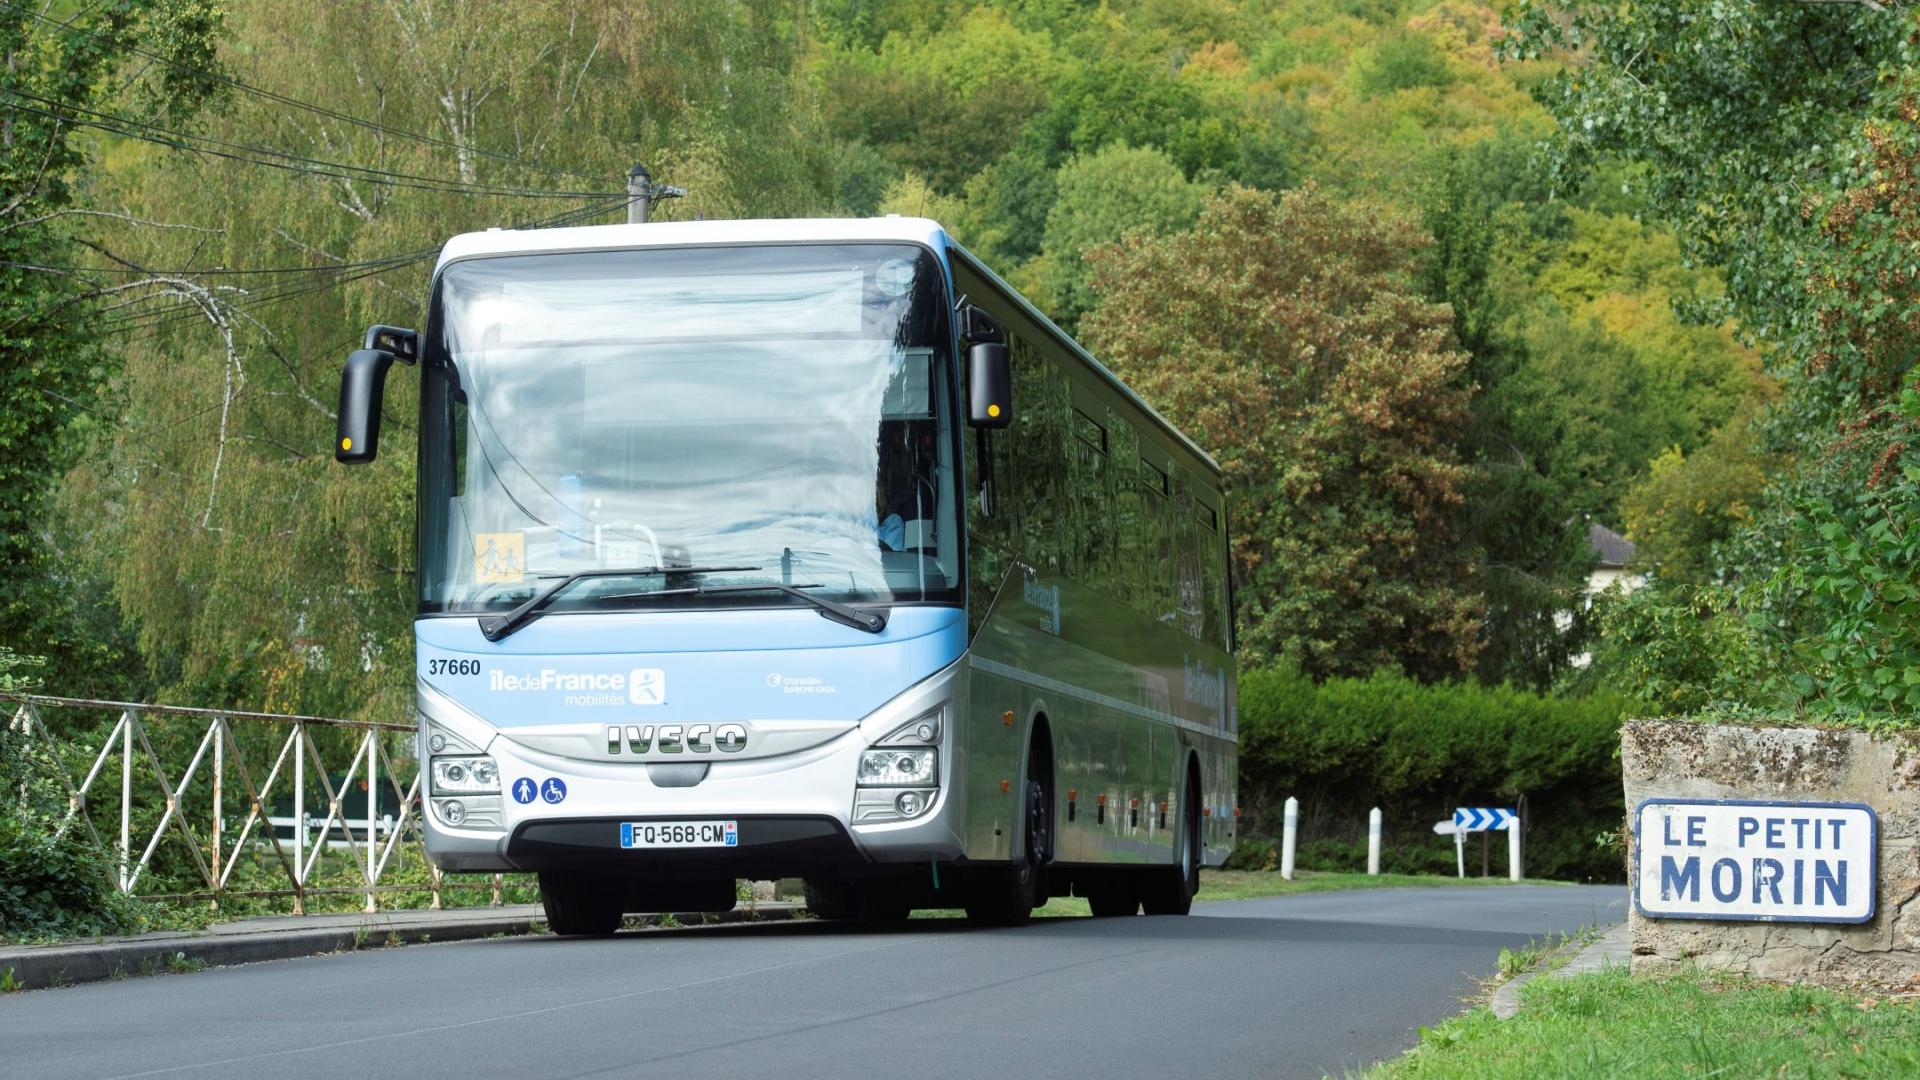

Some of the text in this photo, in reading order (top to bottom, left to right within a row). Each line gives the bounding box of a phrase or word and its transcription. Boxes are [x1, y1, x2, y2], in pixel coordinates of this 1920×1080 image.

[429, 659, 481, 676] 37660
[565, 692, 625, 705] mobilités
[608, 724, 748, 754] IVECO
[633, 825, 737, 844] FQ-568-CM 77
[1664, 816, 1847, 850] LE PETIT
[1660, 855, 1848, 907] MORIN
